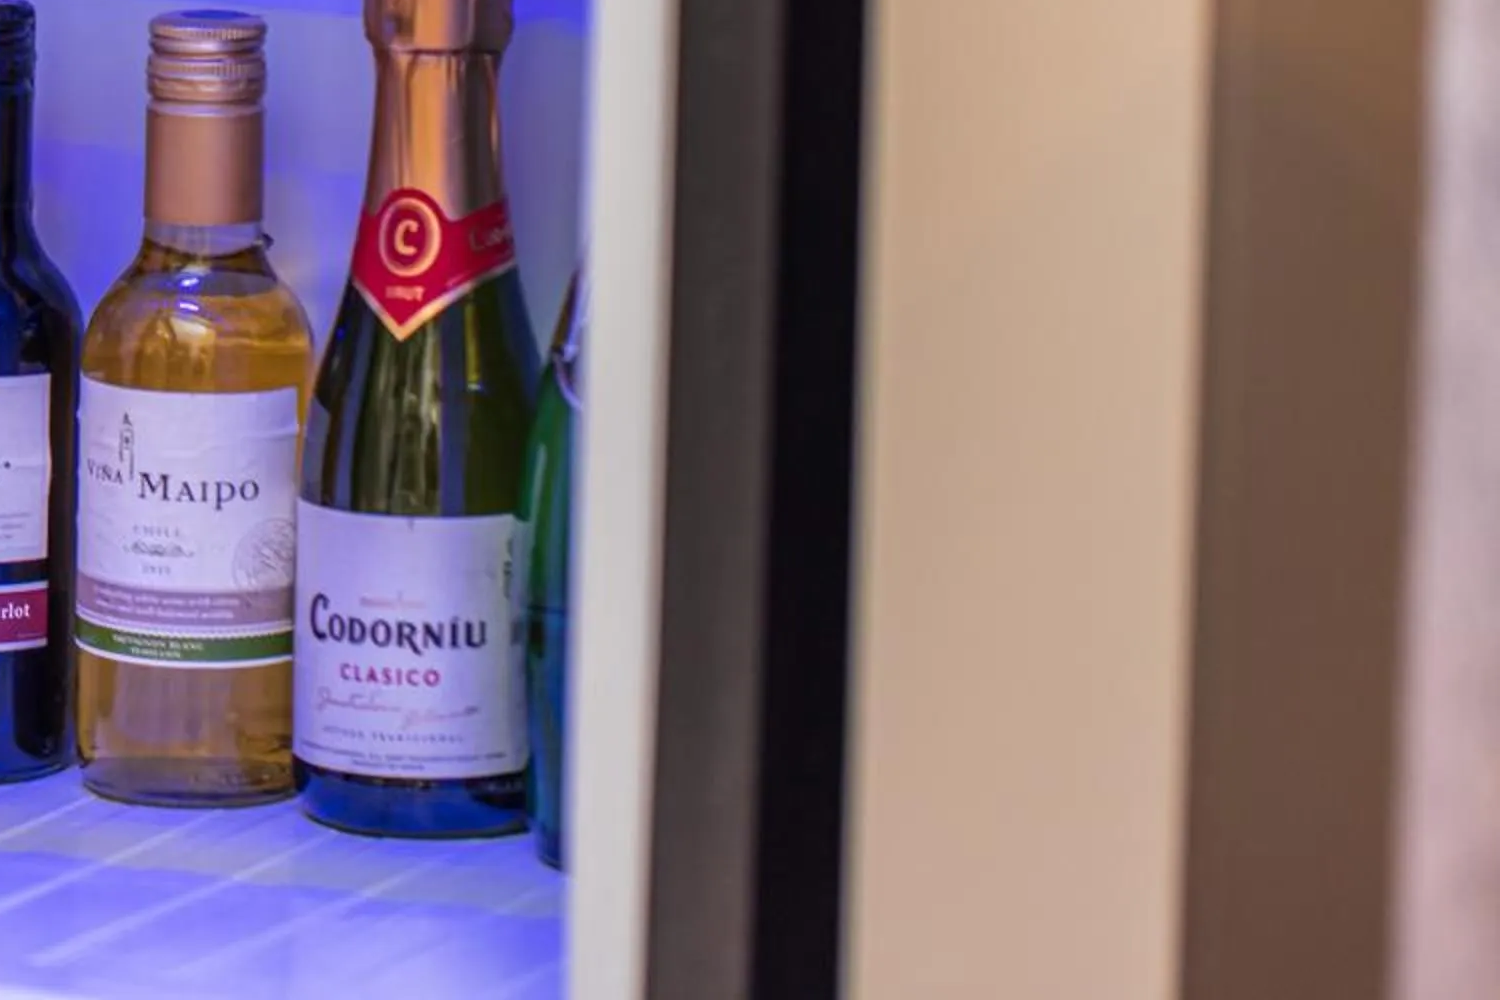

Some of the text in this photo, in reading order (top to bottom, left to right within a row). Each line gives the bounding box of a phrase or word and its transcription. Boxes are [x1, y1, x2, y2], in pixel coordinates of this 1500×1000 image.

[394, 219, 420, 256] C
[87, 457, 123, 484] VIÑA
[340, 662, 442, 688] CLASICO
